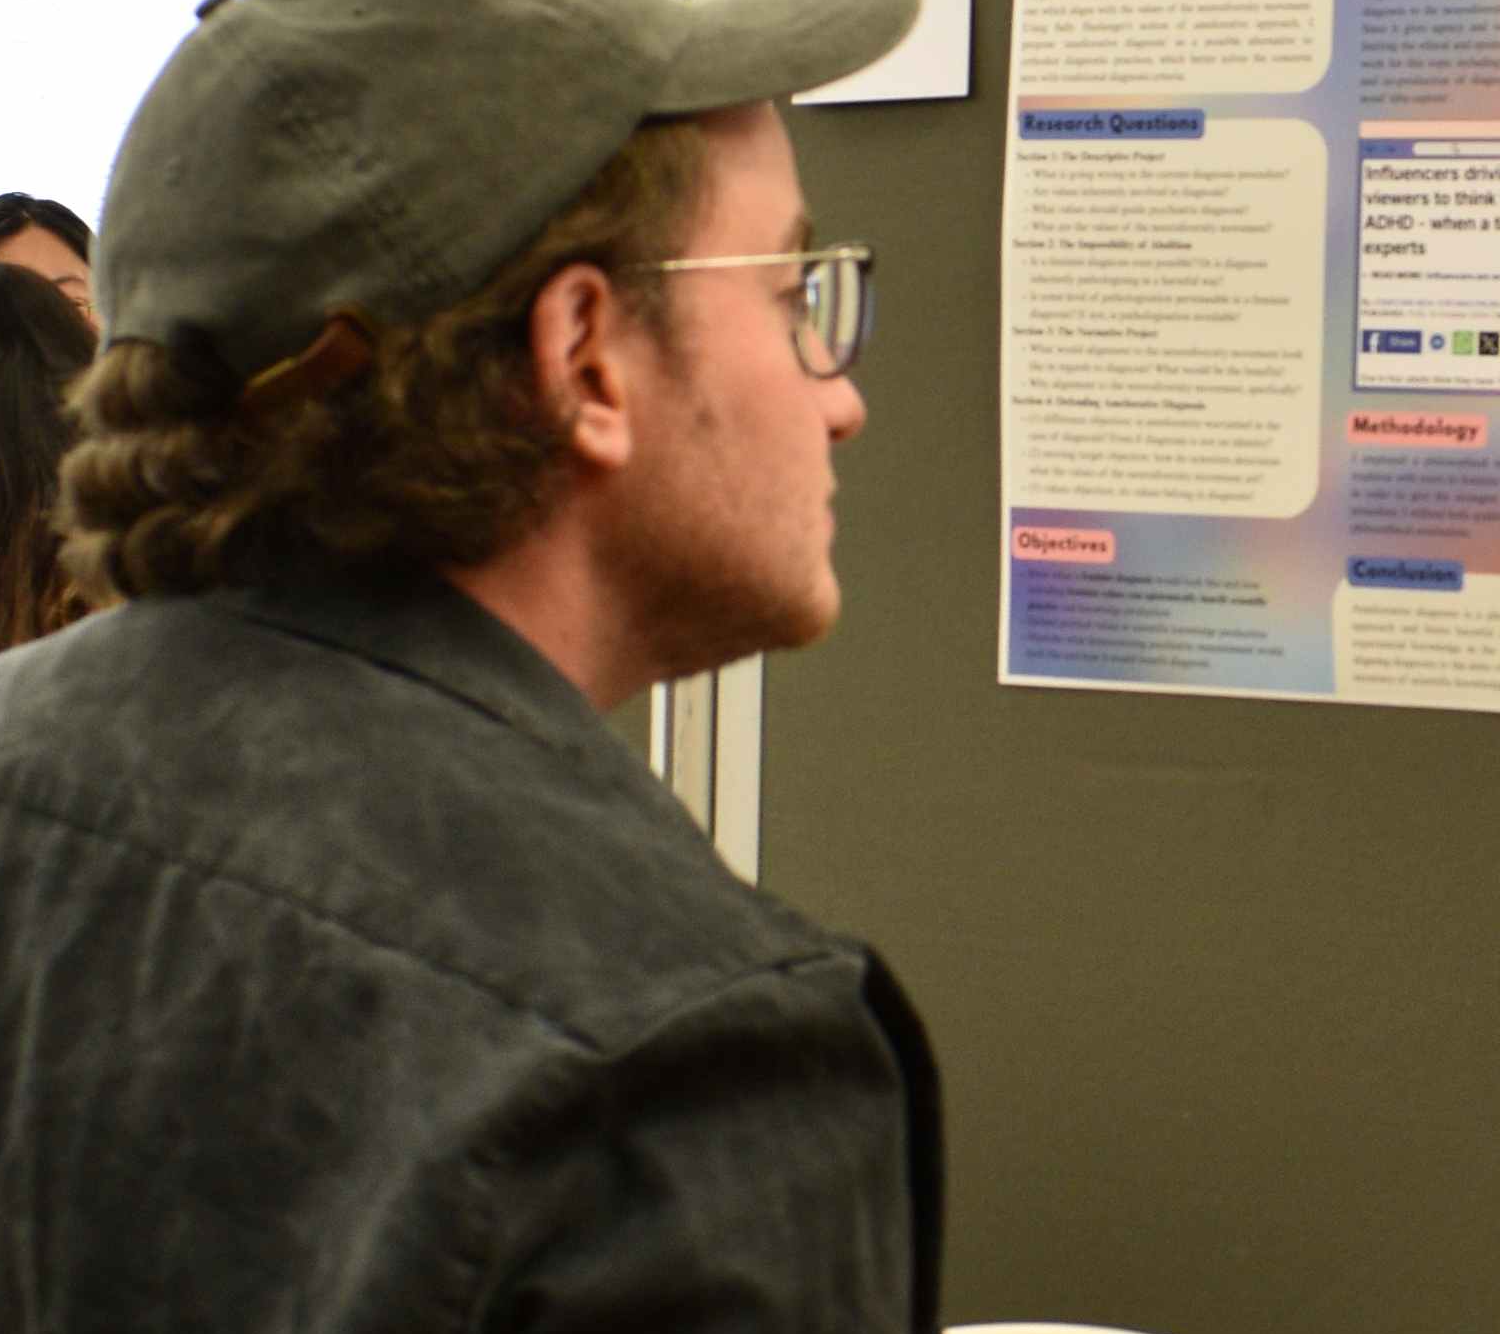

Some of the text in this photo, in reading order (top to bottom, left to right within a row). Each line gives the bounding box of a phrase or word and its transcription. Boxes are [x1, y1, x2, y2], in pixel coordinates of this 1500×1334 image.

[1024, 114, 1198, 134] Research Questions
[1365, 165, 1459, 181] Influencers
[1365, 192, 1429, 206] viewers
[1434, 192, 1449, 206] to
[1455, 191, 1495, 206] think
[1364, 215, 1414, 231] ADHD
[1430, 216, 1476, 232] when
[1480, 219, 1490, 232] a
[1363, 241, 1426, 258] experts
[1353, 417, 1479, 441] Methodology
[1018, 532, 1106, 554] Objectives
[1353, 560, 1458, 582] Conclusion
